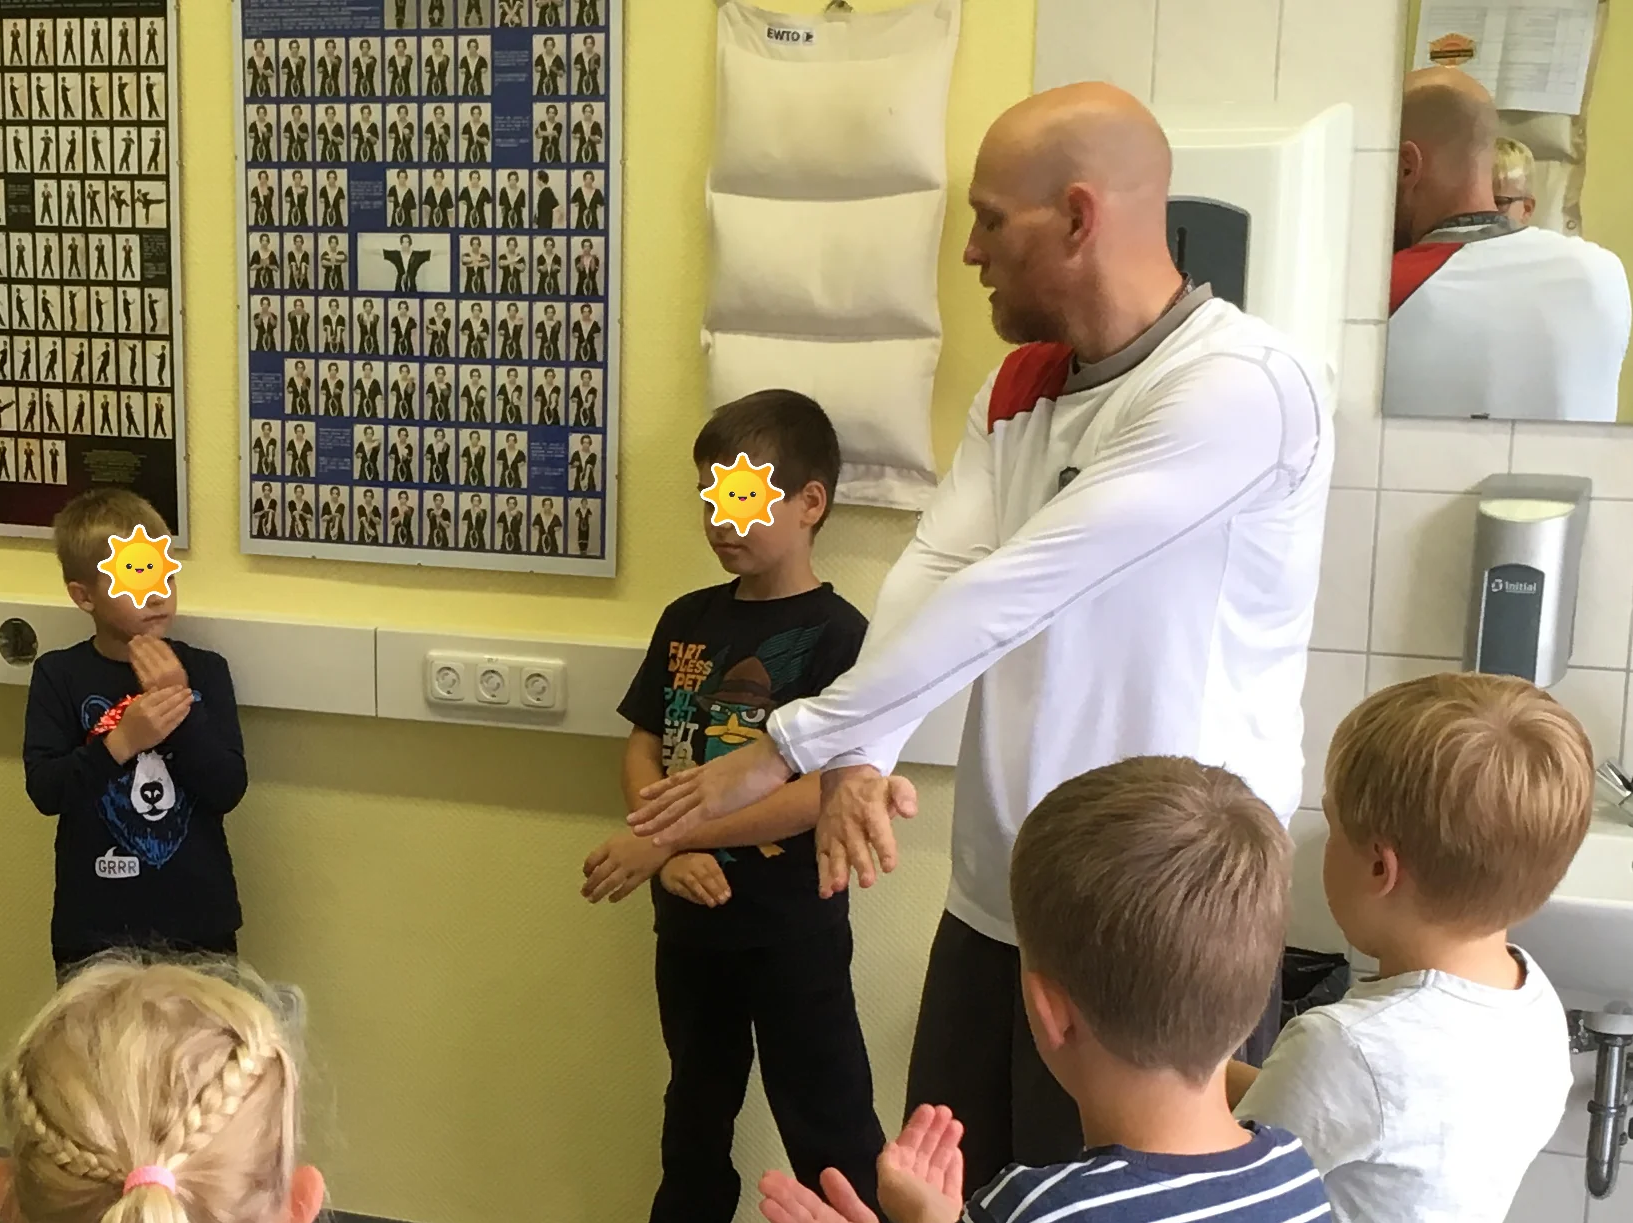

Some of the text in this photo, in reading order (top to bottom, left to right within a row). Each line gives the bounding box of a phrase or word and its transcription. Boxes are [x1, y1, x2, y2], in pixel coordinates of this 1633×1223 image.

[767, 27, 800, 42] EWTO
[1505, 581, 1537, 592] Initial
[673, 672, 707, 692] PET
[99, 860, 137, 874] GRRR
